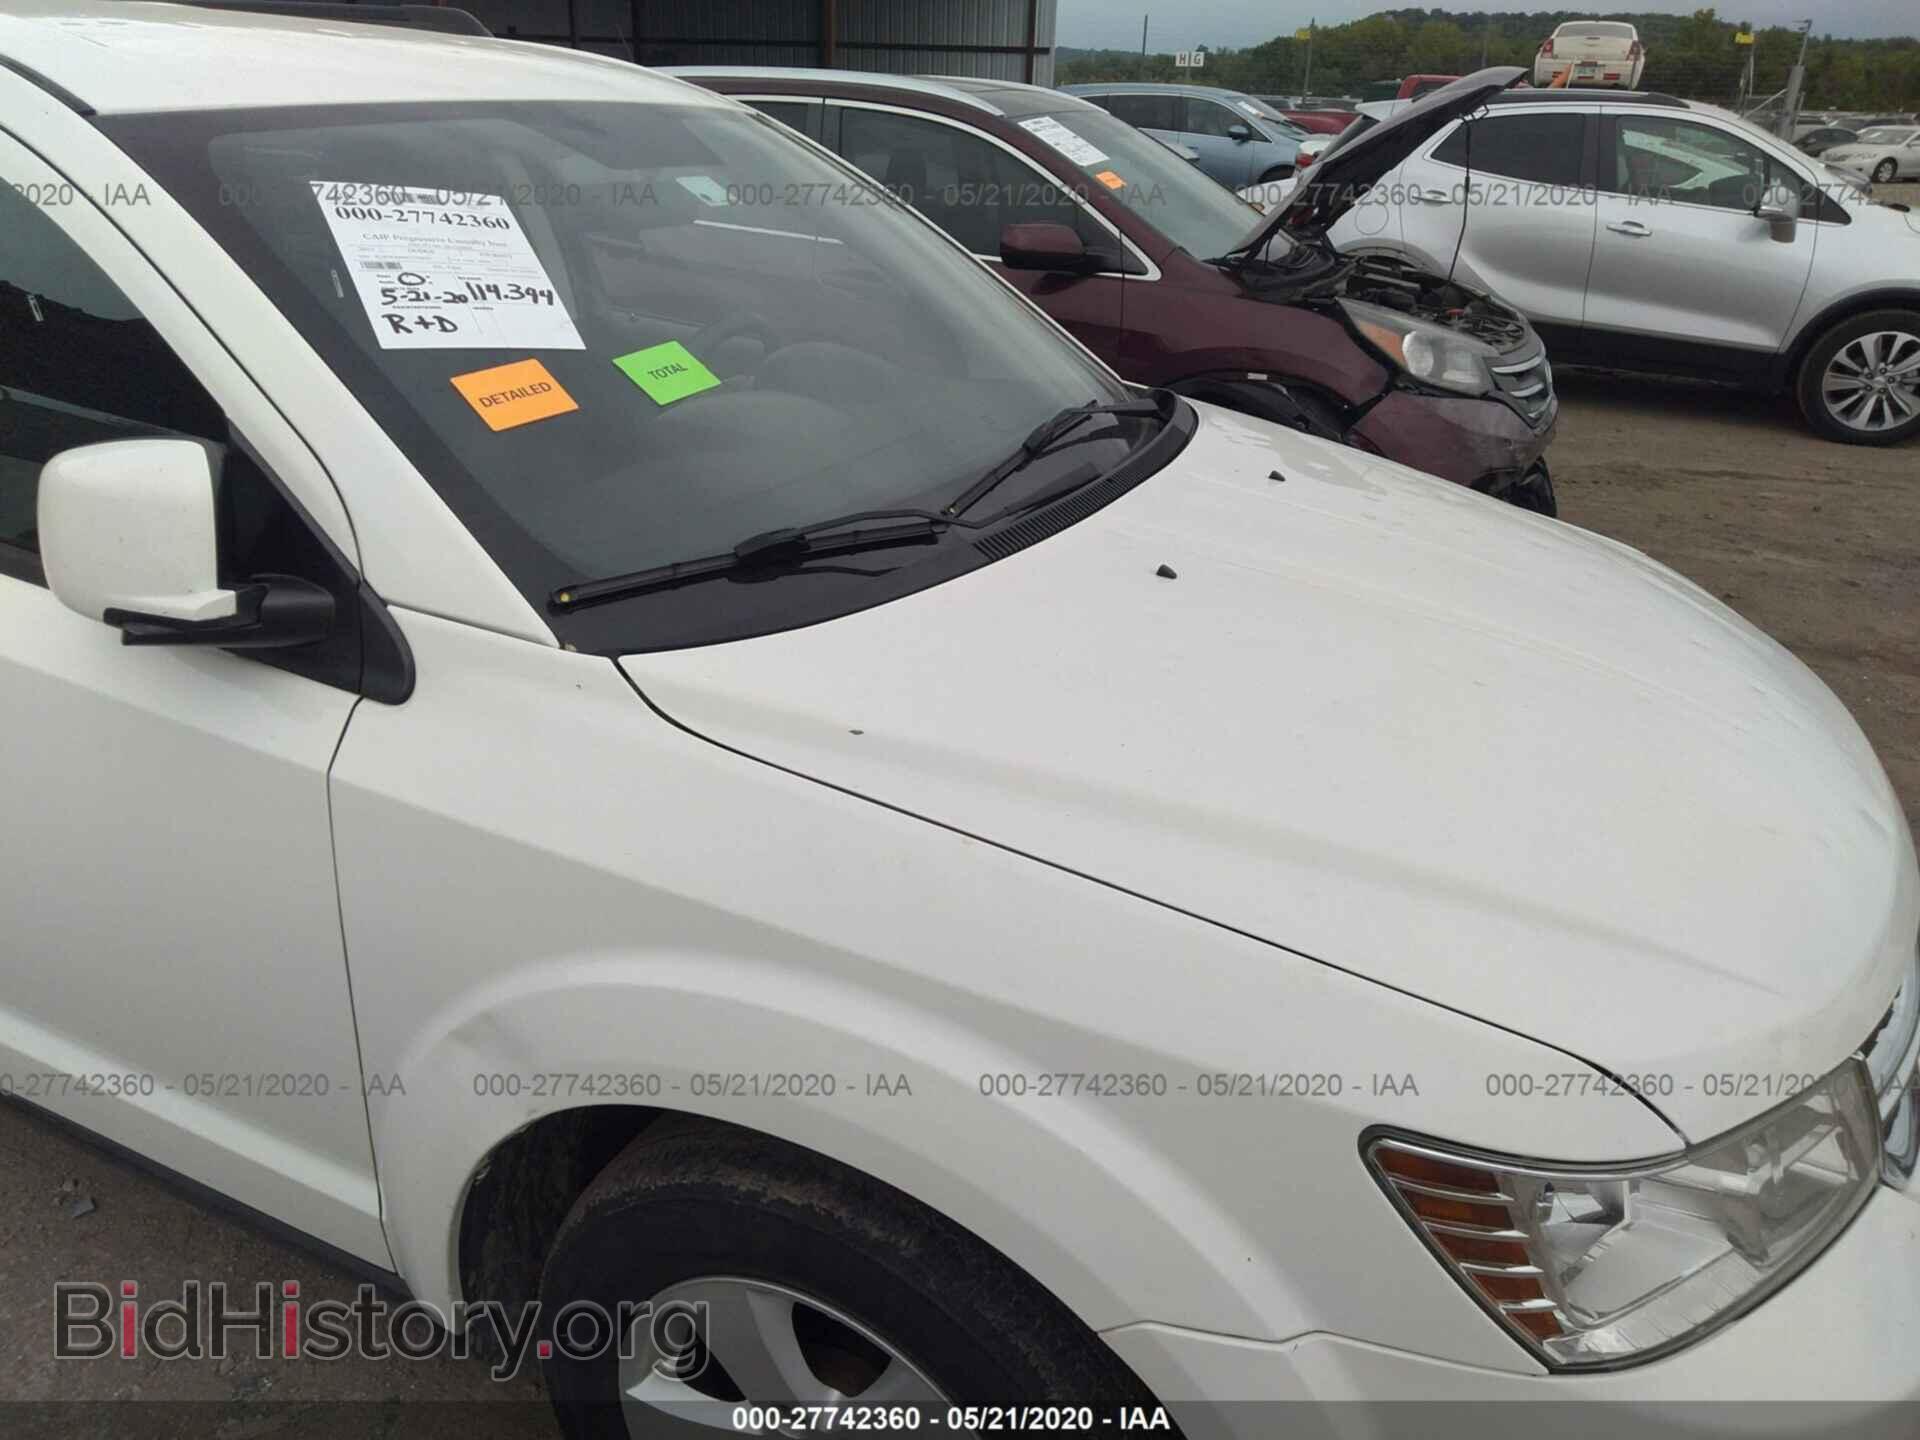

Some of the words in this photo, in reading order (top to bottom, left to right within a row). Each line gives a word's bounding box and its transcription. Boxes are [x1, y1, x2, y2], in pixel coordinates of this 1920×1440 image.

[335, 205, 510, 230] 000-27742360
[648, 363, 688, 380] TOTAL
[479, 382, 551, 407] DETAILED
